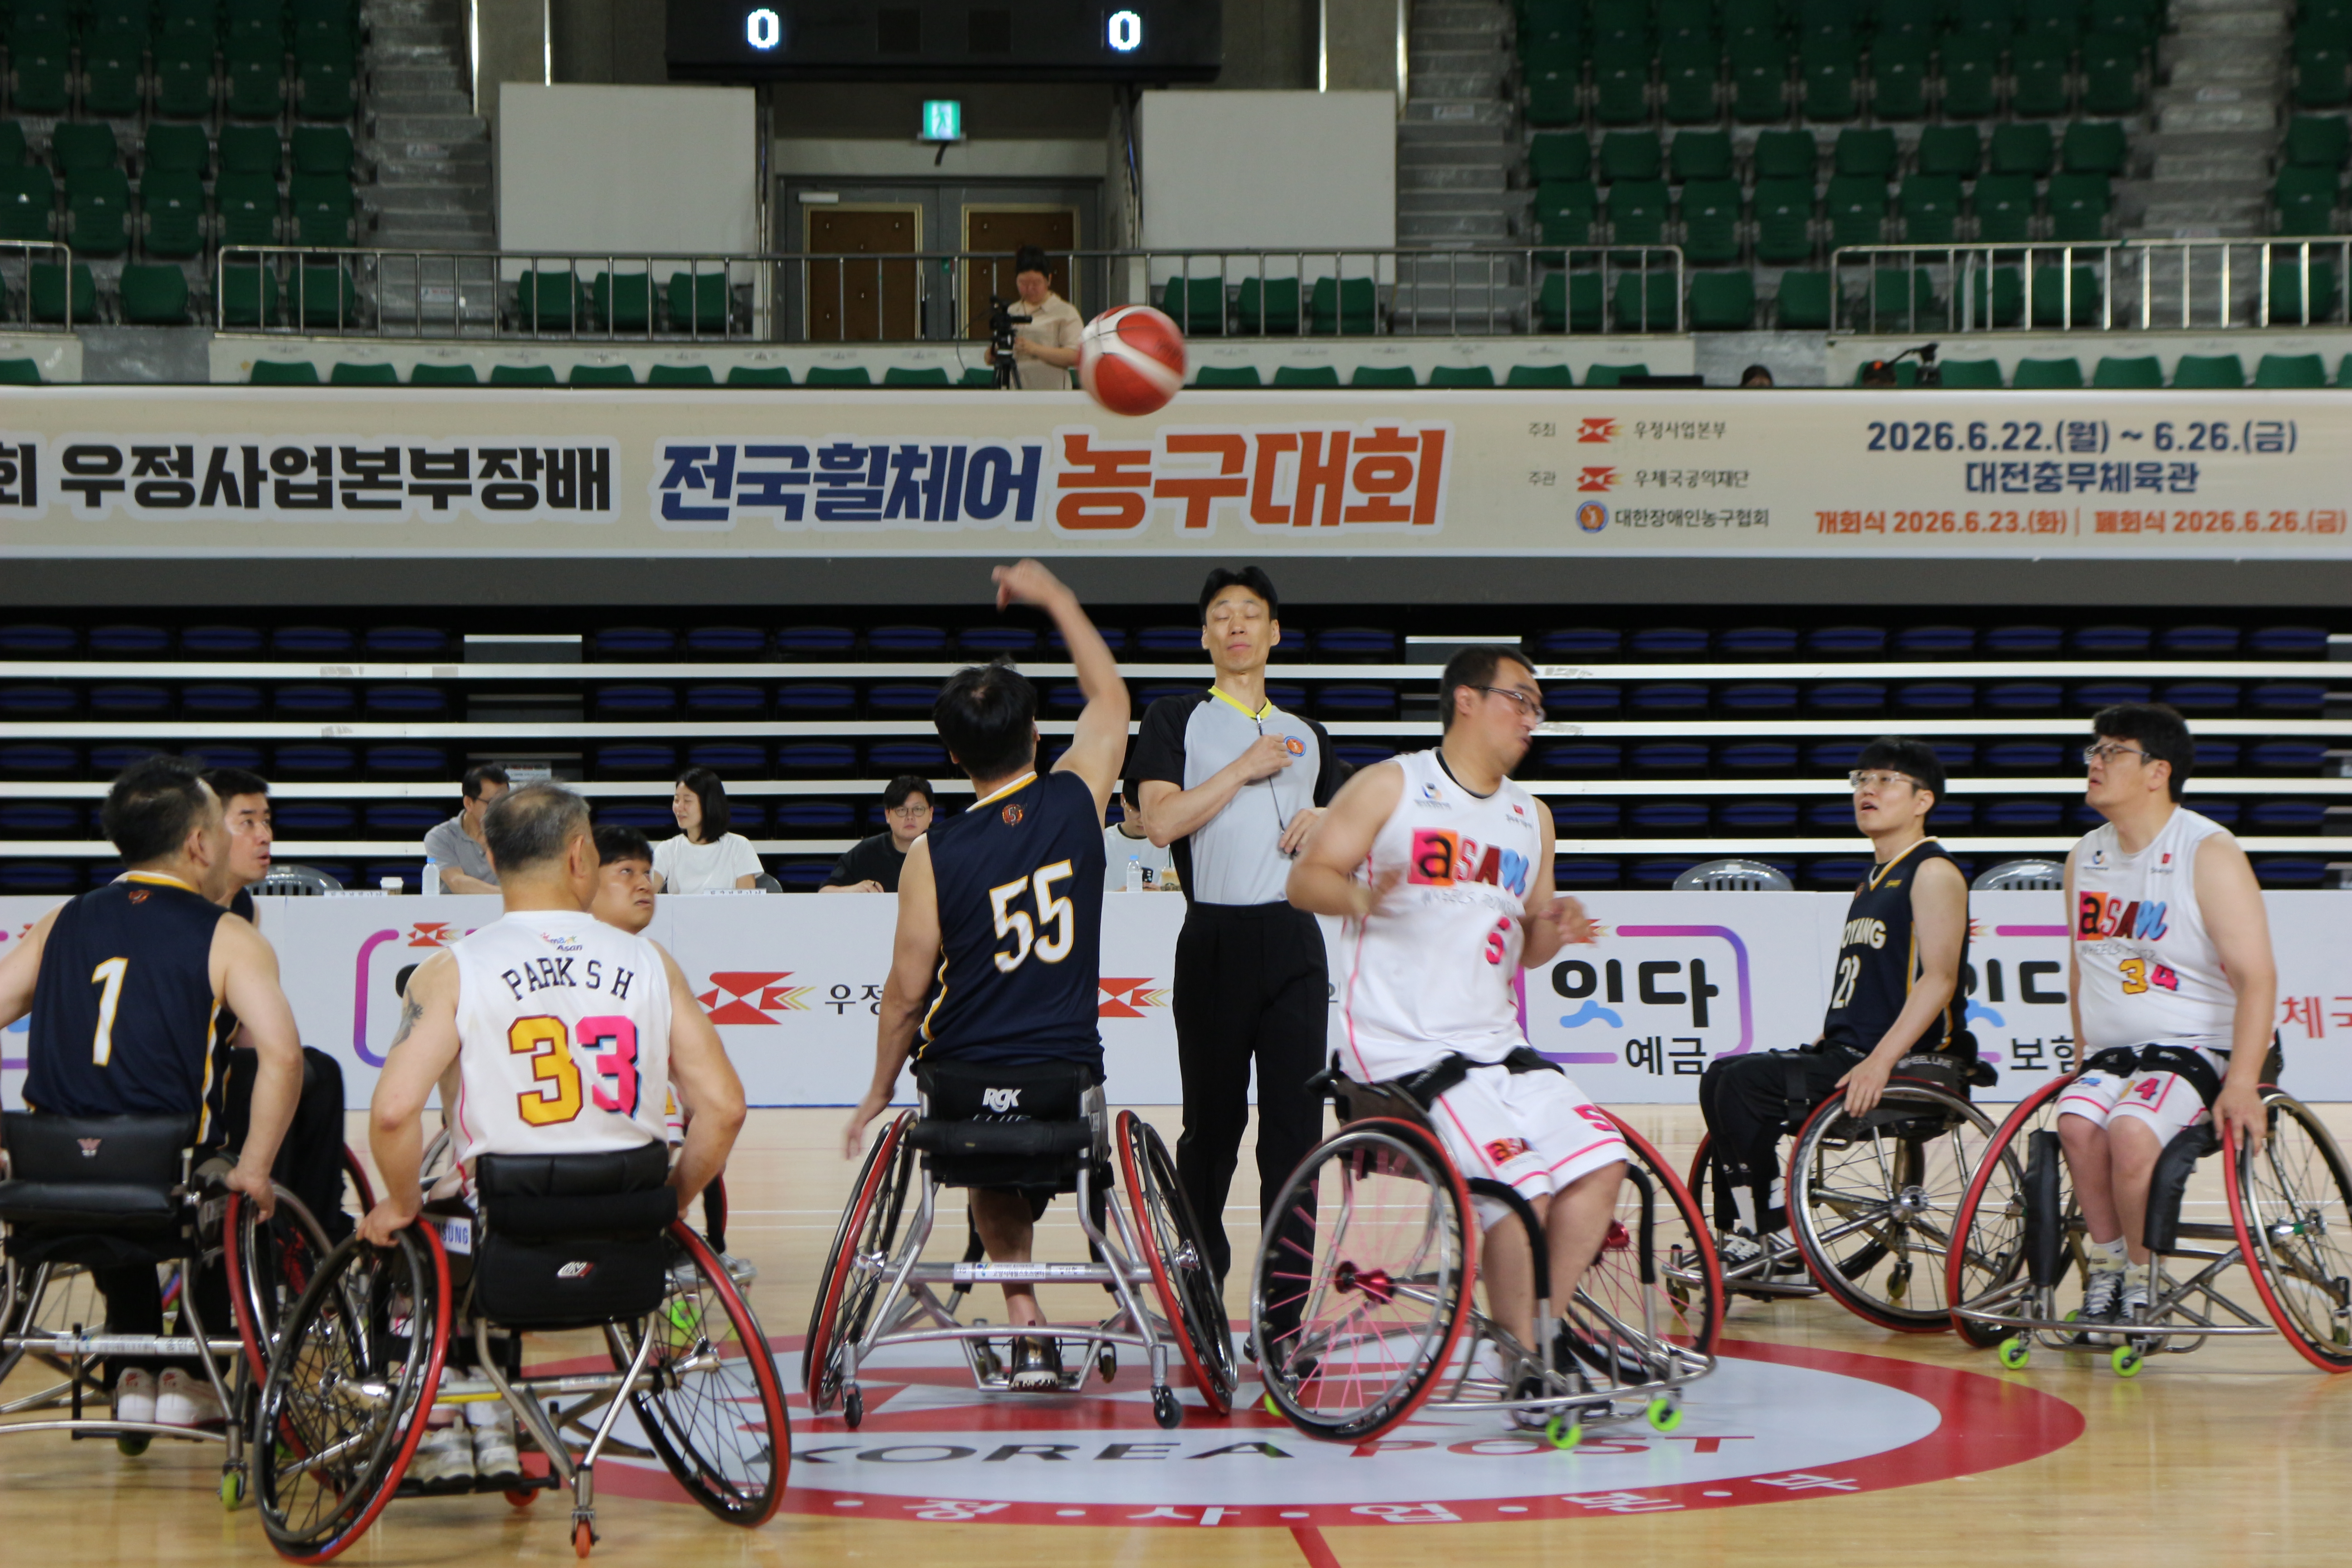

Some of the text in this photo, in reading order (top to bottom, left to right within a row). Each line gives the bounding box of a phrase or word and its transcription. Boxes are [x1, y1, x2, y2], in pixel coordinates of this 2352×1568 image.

[747, 8, 779, 49] 0
[1109, 10, 1141, 51] 0
[1529, 420, 1726, 440] 주최 우정사업본부
[61, 444, 610, 511] 우정사업본부장배
[659, 443, 1043, 522] 전국휠체어
[1055, 427, 1446, 530] 농구대회
[1529, 470, 1749, 488] 주관 우체국공익재단
[1966, 461, 2200, 494] 대전충무체육관
[1615, 509, 1769, 528] 대한장애인농구협회
[1815, 510, 2067, 535] 개회식 2026.6.23.(화)
[2172, 510, 2347, 535] 2026.6.26.(금)
[989, 859, 1073, 973] 55
[1842, 917, 1887, 949] OYANG
[501, 958, 577, 1000] PARK
[1552, 958, 1719, 1028] 잇다
[2119, 957, 2180, 995] 34
[92, 956, 129, 1067] 1
[507, 1014, 641, 1127] 33
[1626, 1036, 1706, 1076] 예금
[743, 1436, 1755, 1464] KOREA POST
